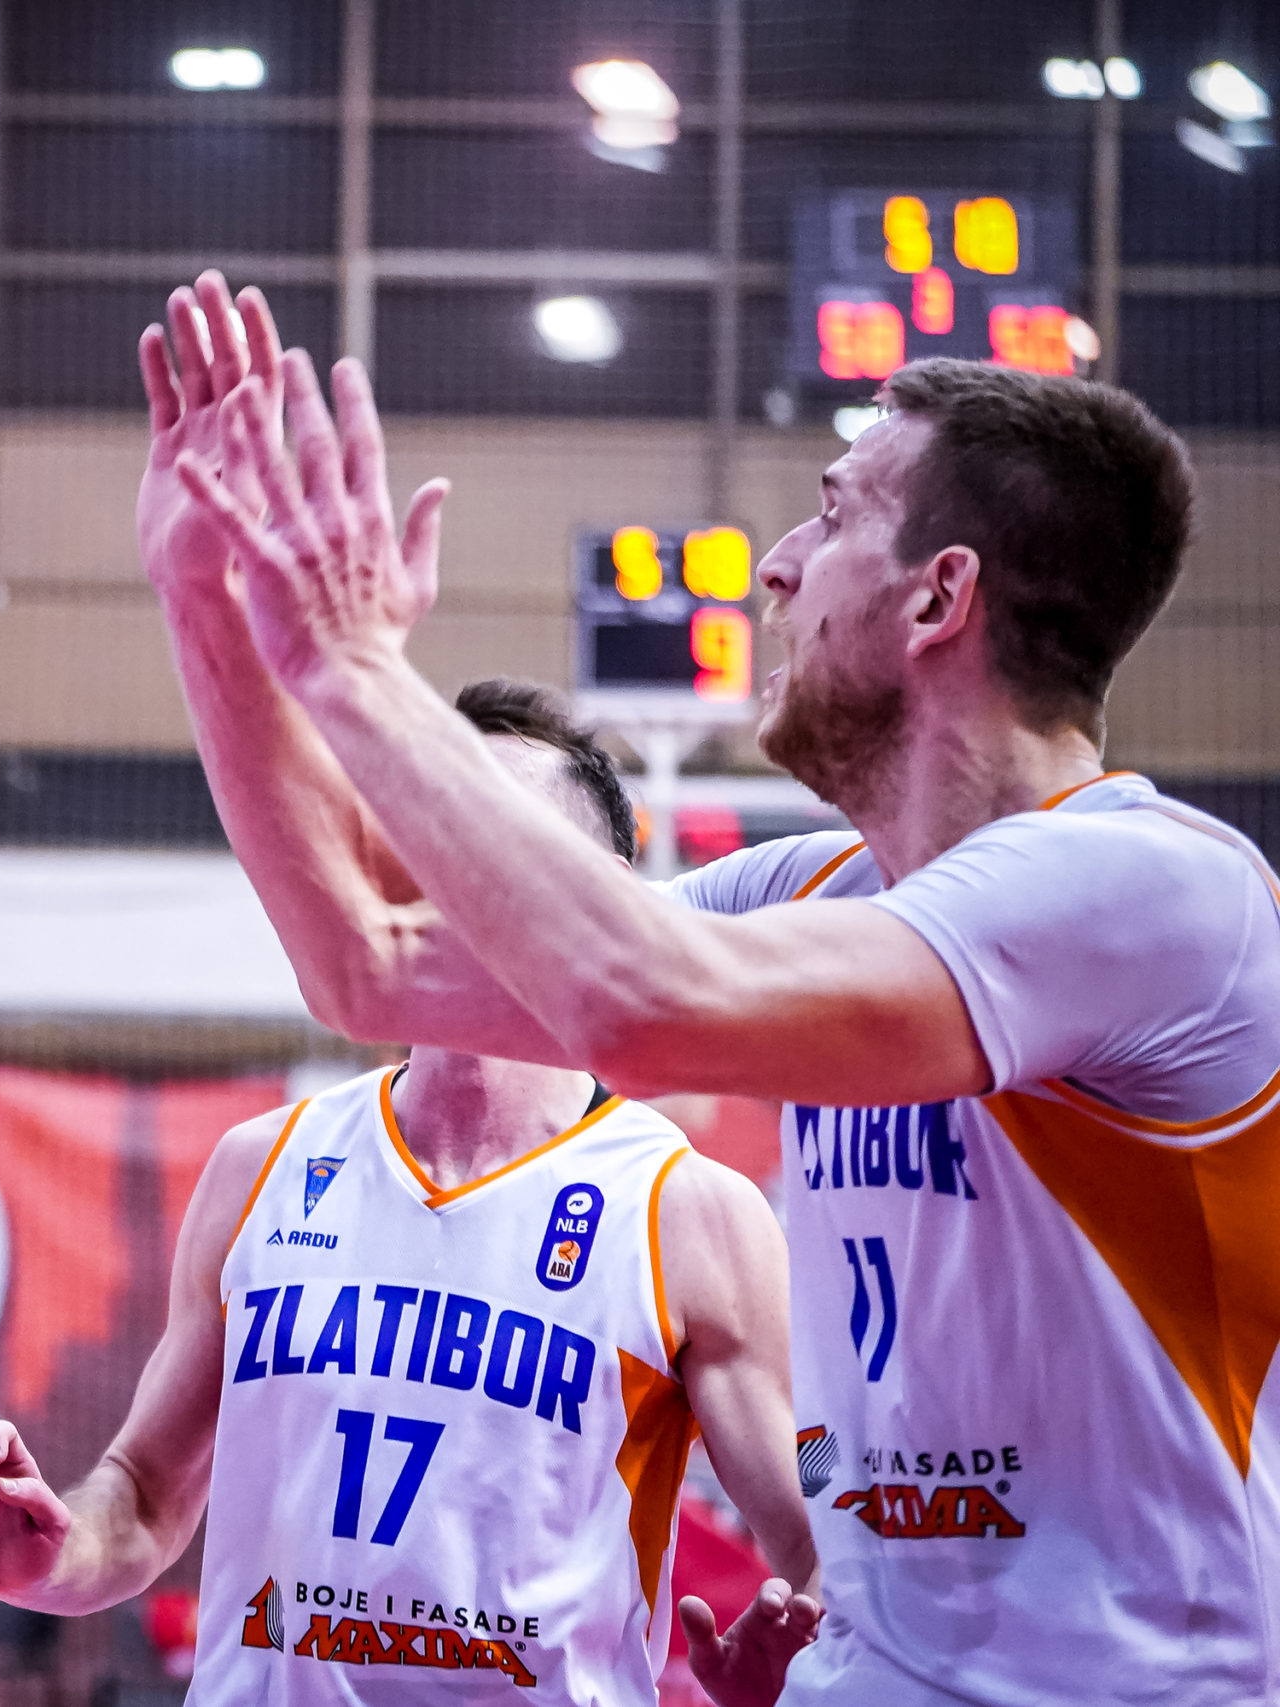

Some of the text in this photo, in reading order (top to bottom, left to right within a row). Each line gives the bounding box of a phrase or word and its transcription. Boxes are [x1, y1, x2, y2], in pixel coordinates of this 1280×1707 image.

[287, 1230, 339, 1250] ARDU
[555, 1217, 589, 1234] NLB
[549, 1260, 571, 1278] ABA
[232, 1284, 597, 1435] ZLATIBOR
[332, 1408, 447, 1547] 17
[296, 1581, 540, 1639] BOJE I FASADE
[293, 1613, 538, 1689] MAXIMA
